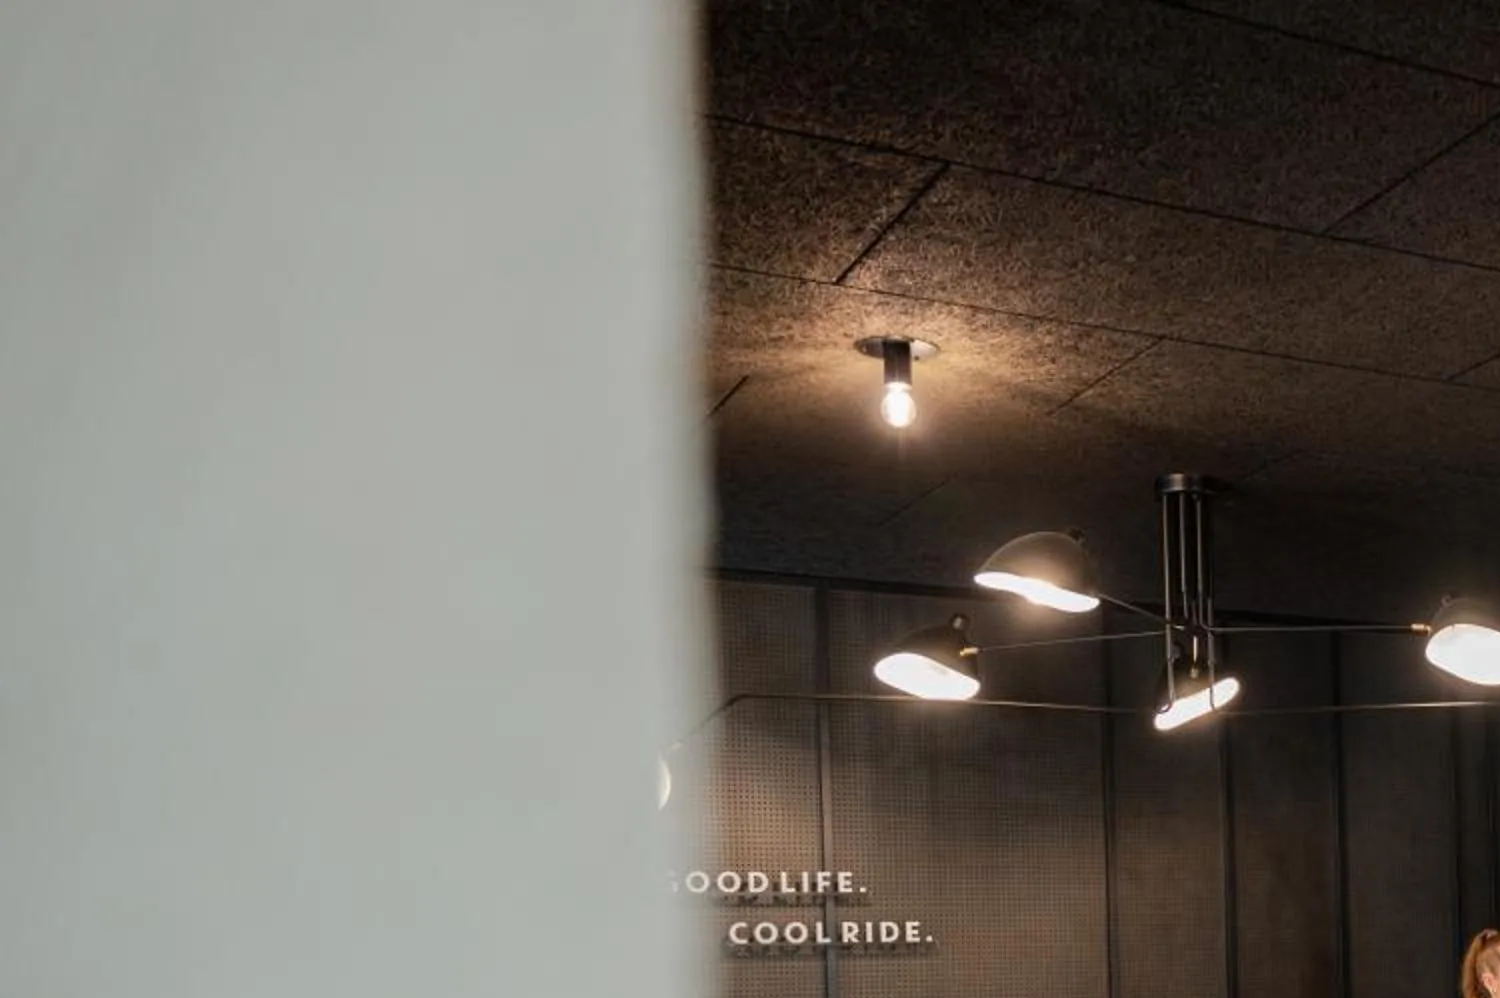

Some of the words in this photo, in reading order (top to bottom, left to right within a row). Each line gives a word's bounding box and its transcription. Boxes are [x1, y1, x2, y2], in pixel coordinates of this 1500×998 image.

[780, 871, 867, 893] LIFE.
[728, 921, 832, 944] COOL
[841, 921, 934, 943] RIDE.
